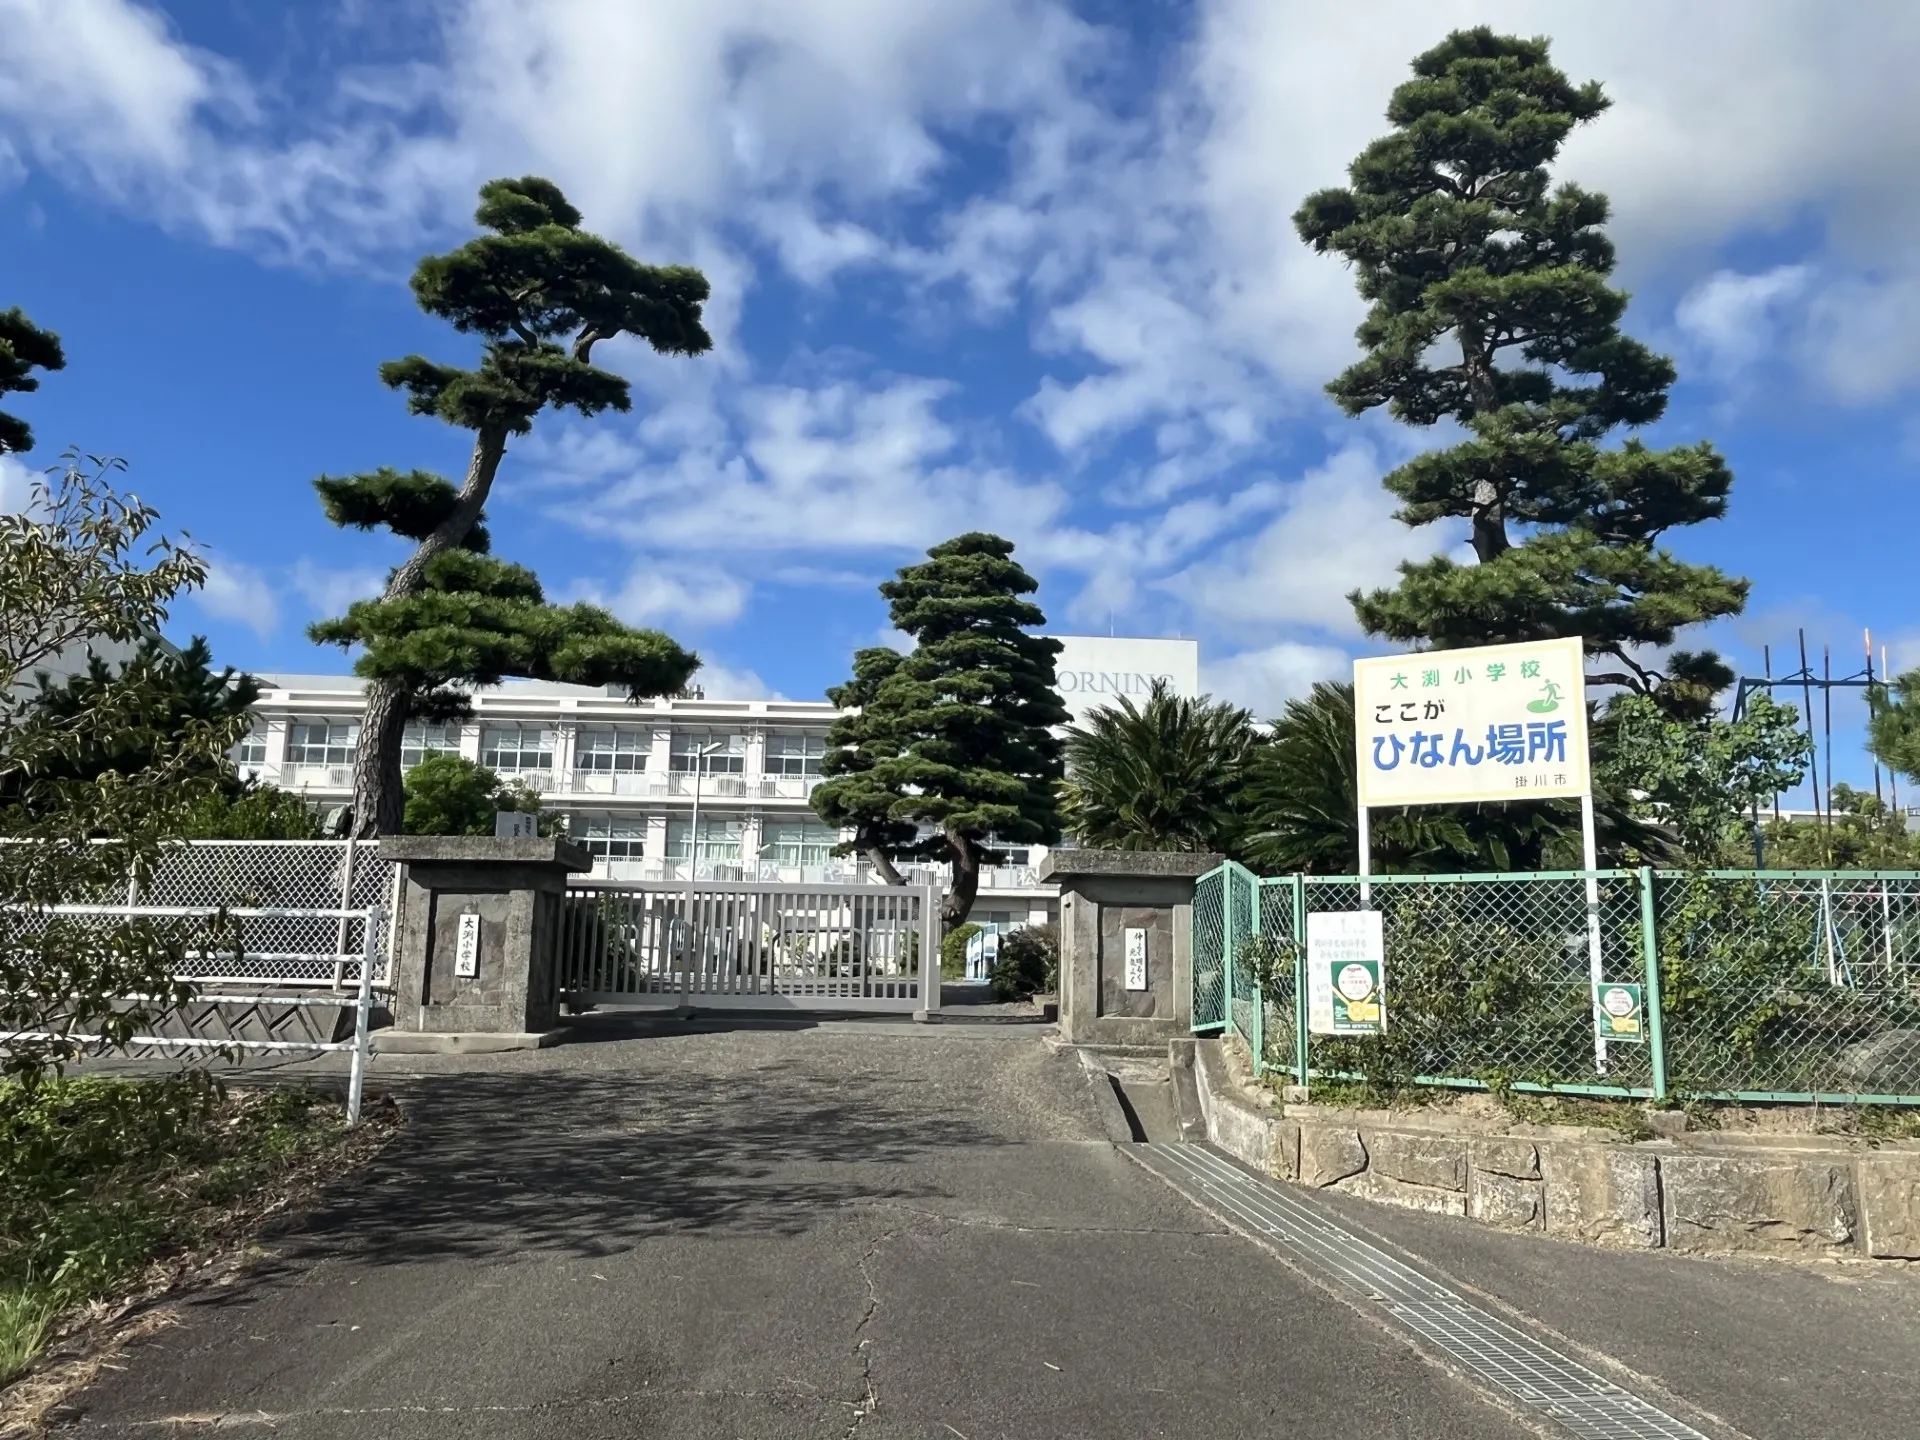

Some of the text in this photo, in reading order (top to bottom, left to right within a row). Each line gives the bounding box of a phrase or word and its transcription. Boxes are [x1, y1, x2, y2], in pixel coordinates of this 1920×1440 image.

[1056, 670, 1176, 694] ORNING
[1390, 660, 1541, 690] 大渕小学校
[1375, 699, 1445, 723] ここが
[1372, 720, 1567, 771] ひなん場所
[1515, 773, 1567, 789] 掛川市
